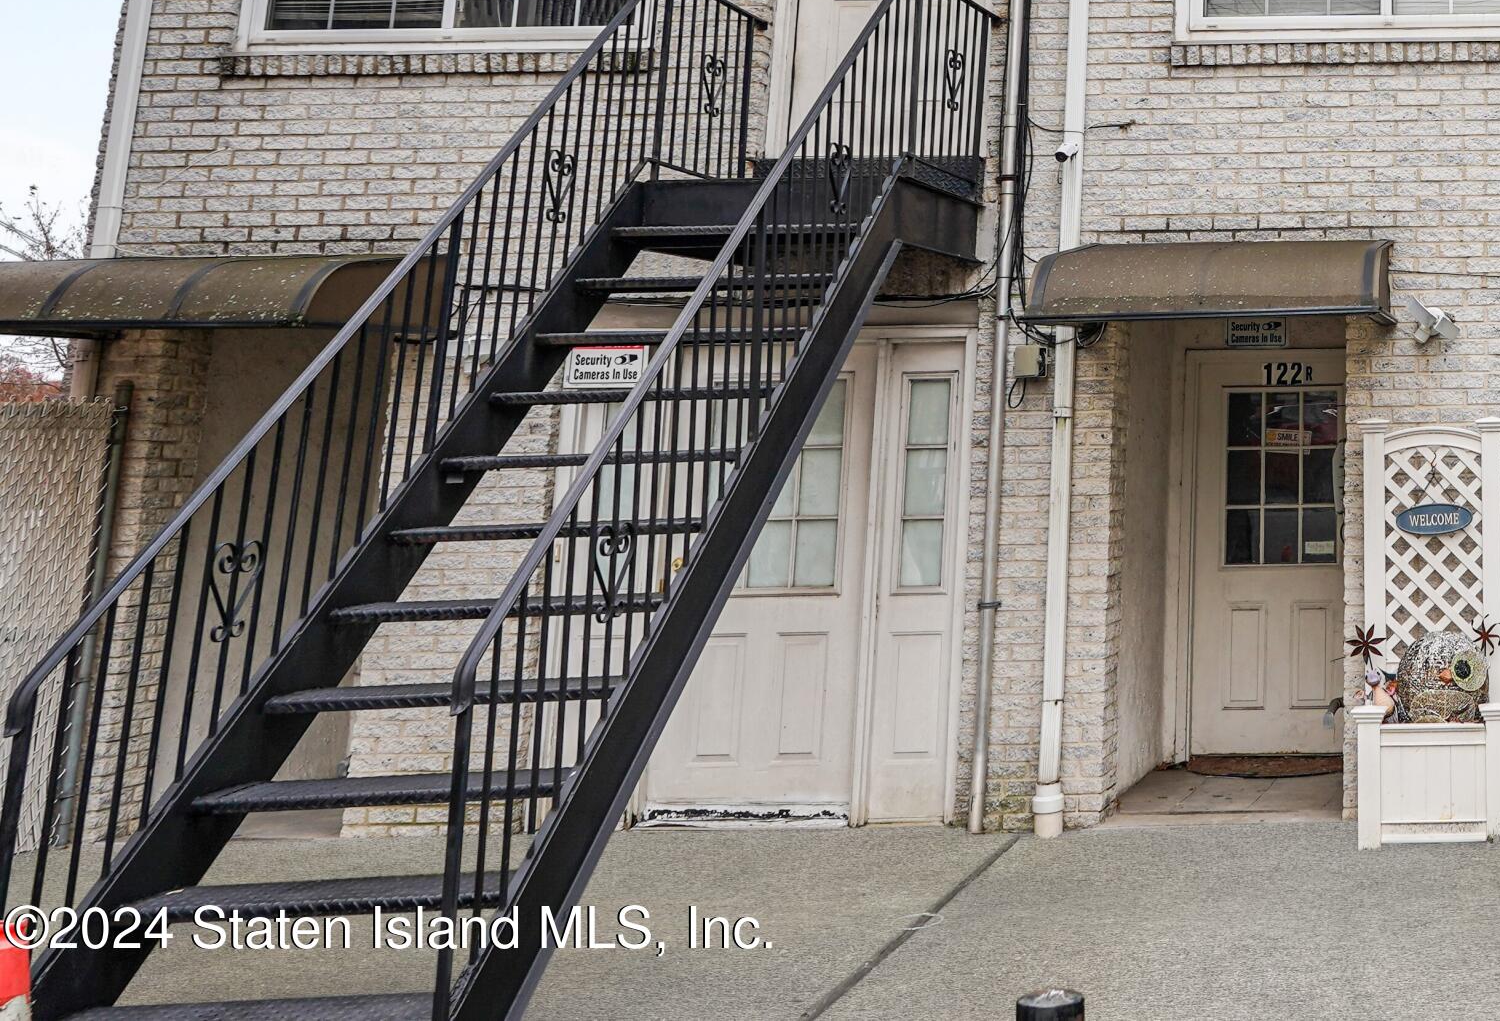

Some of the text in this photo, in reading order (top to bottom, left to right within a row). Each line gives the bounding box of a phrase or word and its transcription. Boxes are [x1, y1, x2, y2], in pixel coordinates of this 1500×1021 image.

[1231, 322, 1260, 332] Security
[1231, 333, 1282, 344] Cameras In Use
[575, 354, 612, 367] Security
[573, 368, 638, 380] Cameras In Use
[1277, 432, 1298, 441] SMILE
[1409, 512, 1460, 527] WELCOME
